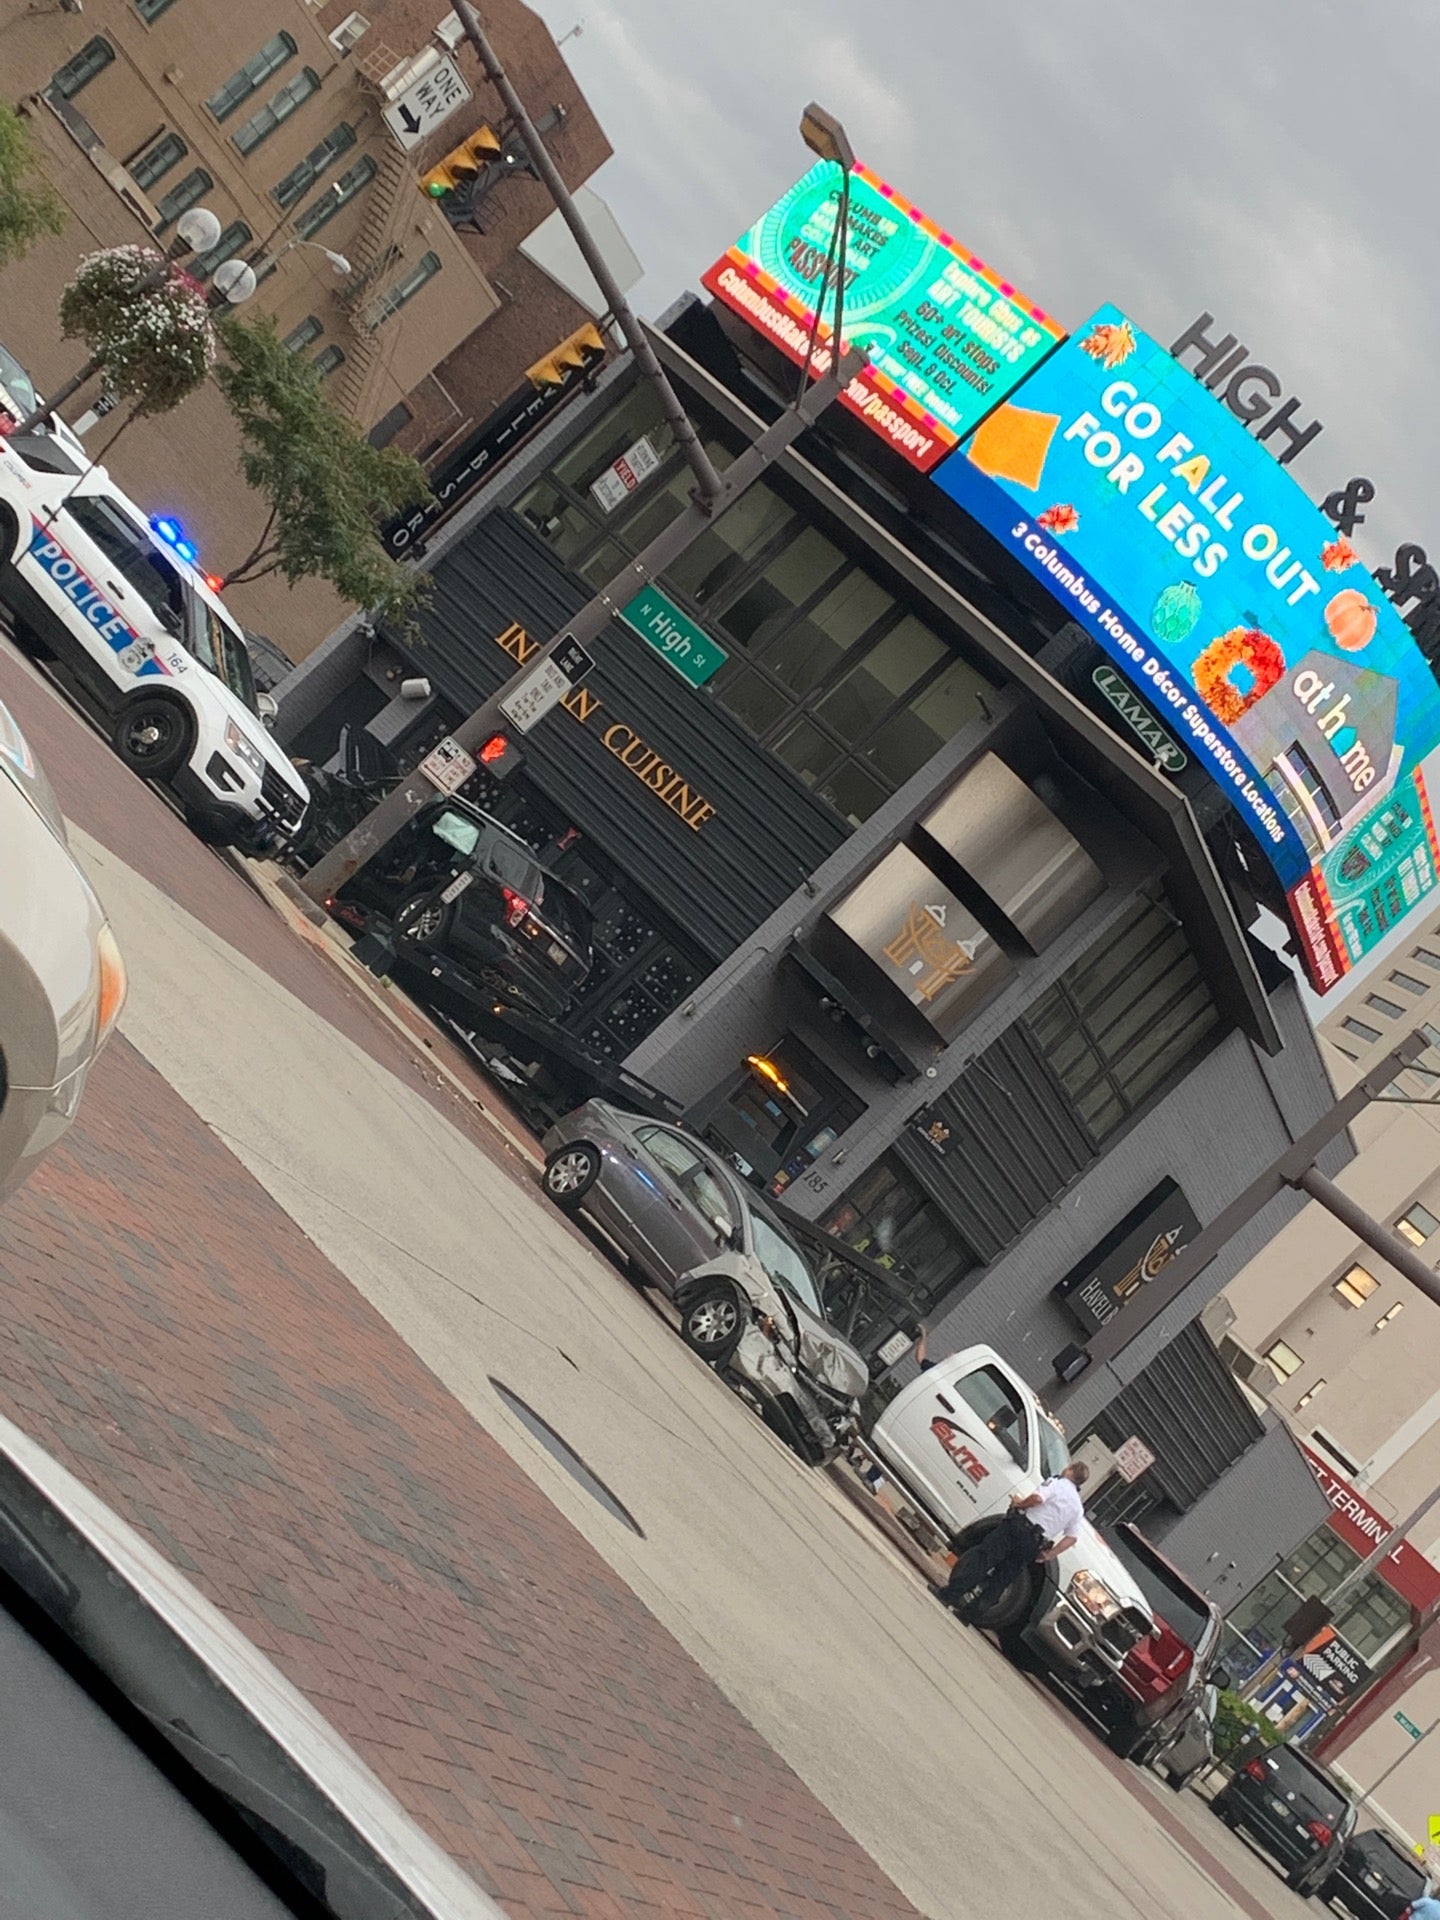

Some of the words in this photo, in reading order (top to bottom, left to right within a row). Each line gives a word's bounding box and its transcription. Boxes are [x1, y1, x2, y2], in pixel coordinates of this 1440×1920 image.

[415, 80, 445, 119] WAY
[433, 66, 462, 105] ONE
[828, 189, 899, 237] CLUMBUS
[851, 237, 880, 259] ART
[940, 323, 967, 347] art
[961, 340, 1000, 376] stops
[956, 300, 1026, 364] TOURISTS
[897, 340, 924, 371] Sept.
[933, 369, 957, 396] Oct.
[901, 370, 931, 398] FREE
[931, 341, 995, 396] Discounts!
[497, 356, 592, 444] VELI
[1170, 311, 1324, 464] HIGH
[1321, 477, 1375, 537] &
[616, 461, 636, 489] YIELD
[1063, 410, 1145, 495] FOR
[1137, 482, 1229, 578] LESS
[1101, 381, 1162, 439] GO
[1155, 431, 1244, 532] FALL
[1242, 523, 1321, 607] OUT
[33, 540, 130, 641] POLICE
[166, 652, 189, 675] 164
[639, 603, 651, 617] N
[648, 611, 694, 659] High
[692, 653, 707, 669] St
[1011, 521, 1029, 539] 3
[1023, 533, 1101, 614] Columbus
[1097, 609, 1147, 663] Home
[1141, 657, 1189, 709] Décor
[1182, 704, 1248, 787] Superstore
[1241, 780, 1286, 844] Locations
[1293, 669, 1335, 715] at
[494, 620, 603, 724] INN
[599, 724, 717, 832] CUISINE
[1101, 674, 1178, 761] LAMAR
[803, 1170, 829, 1194] 185
[1078, 1276, 1111, 1319] HAVELI
[929, 1421, 991, 1483] ELITE
[1326, 1479, 1403, 1564] TERMINL
[1322, 1646, 1359, 1684] PARKING
[1329, 1640, 1359, 1670] PUBLIC
